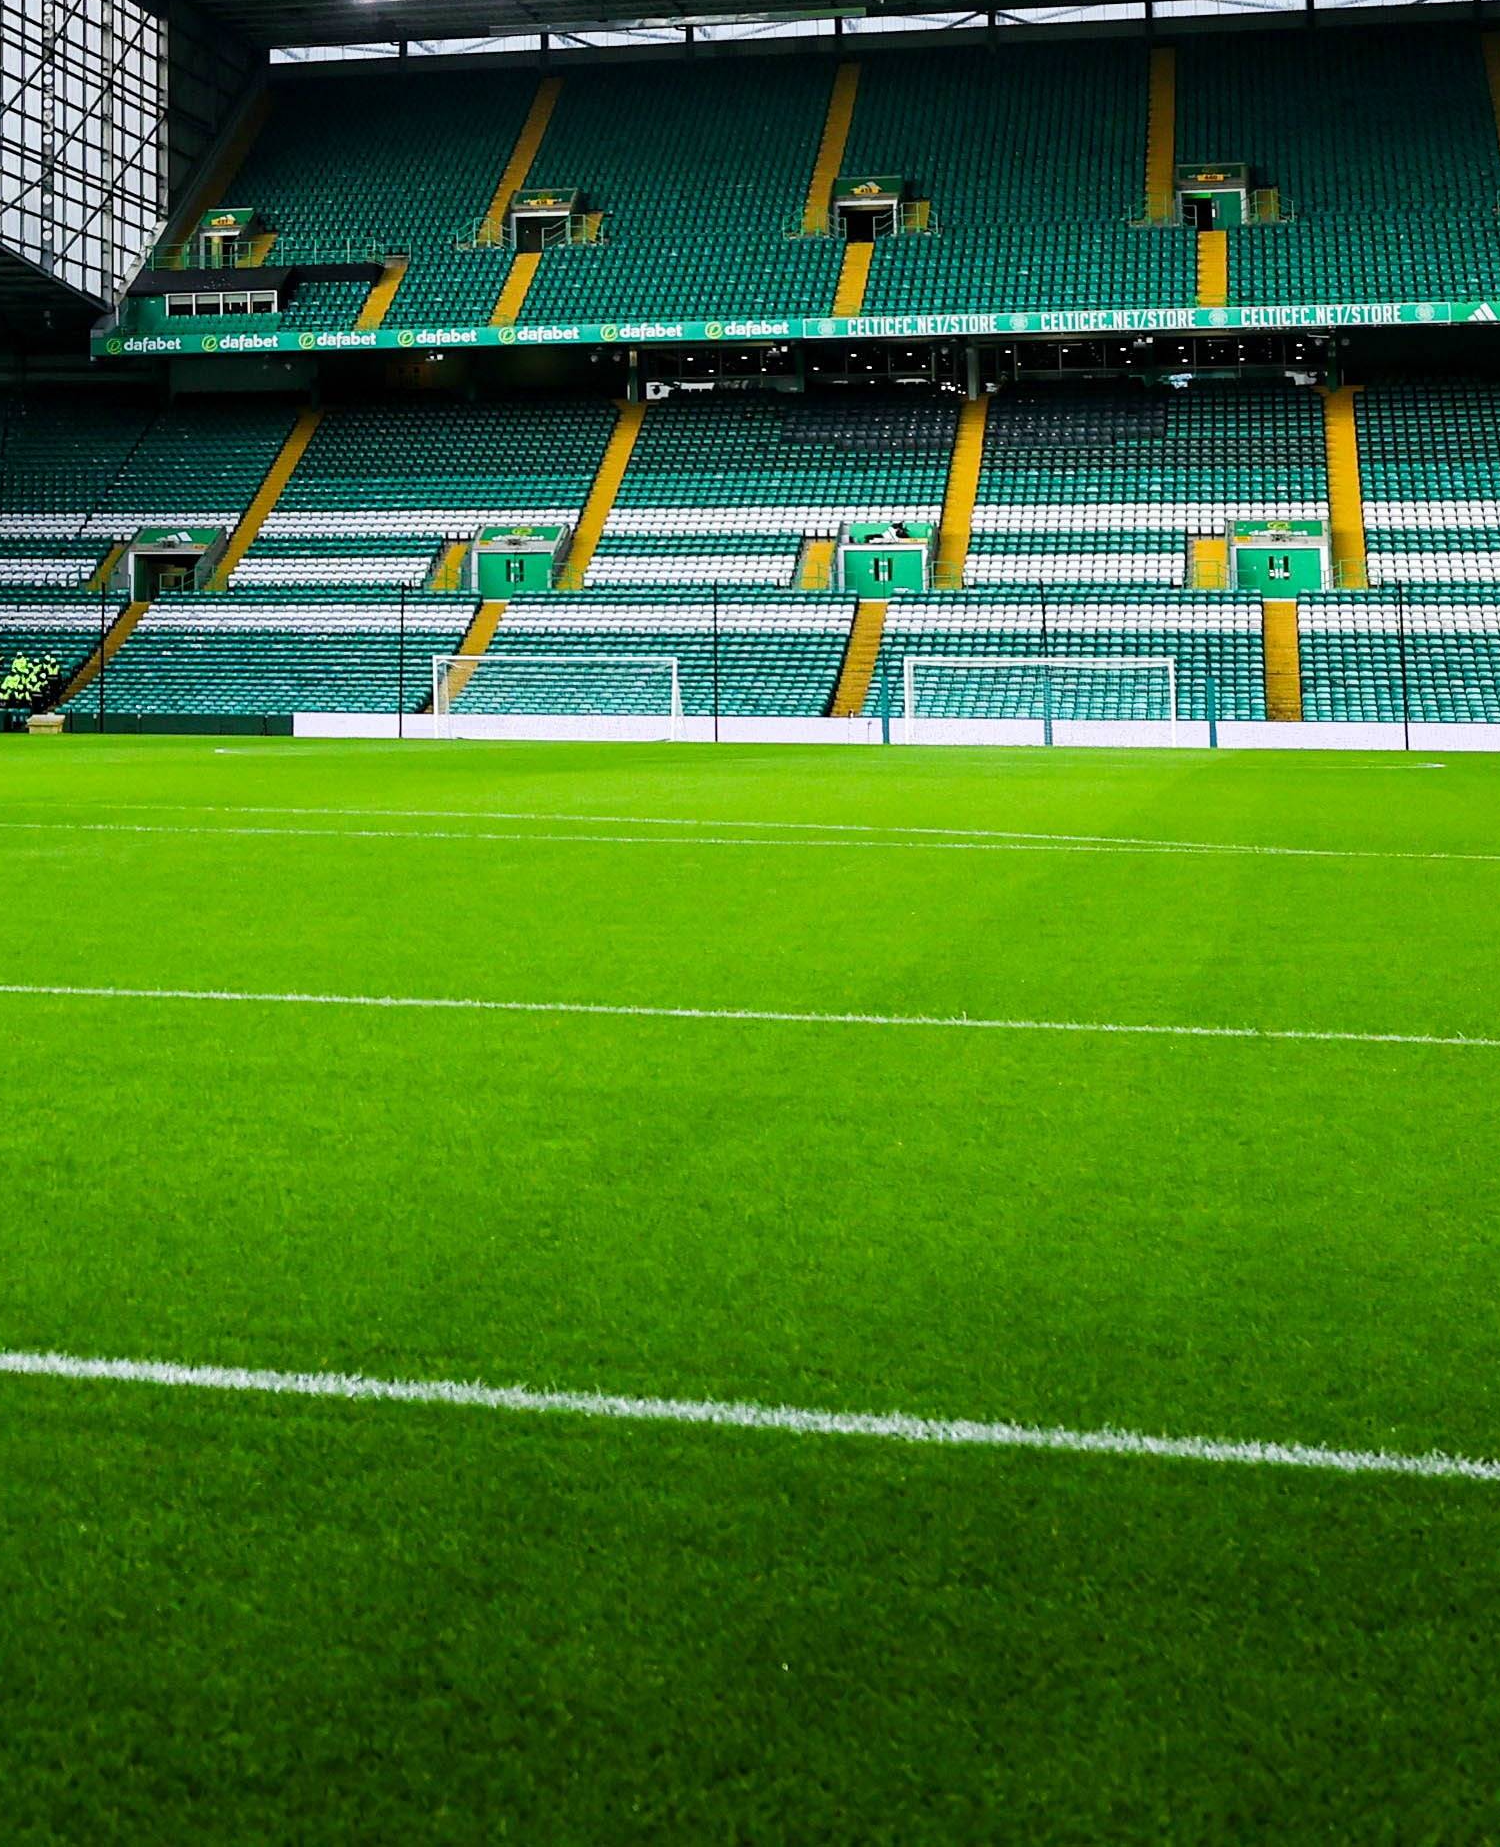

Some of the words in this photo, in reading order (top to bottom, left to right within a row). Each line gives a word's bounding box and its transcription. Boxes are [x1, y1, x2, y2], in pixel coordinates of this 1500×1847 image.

[1041, 309, 1196, 331] CELTICFC.NET/STORE
[1241, 304, 1401, 327] CELTICFC.NET/STORE
[619, 323, 682, 341] dafabet
[724, 321, 788, 337] dafabet
[848, 315, 998, 335] CELTICFC.NET/STORE
[219, 334, 279, 351] dafabet
[317, 332, 376, 348] dafabet
[416, 329, 477, 345] dafabet
[517, 326, 580, 343] dafabet
[124, 337, 181, 352] dafabet
